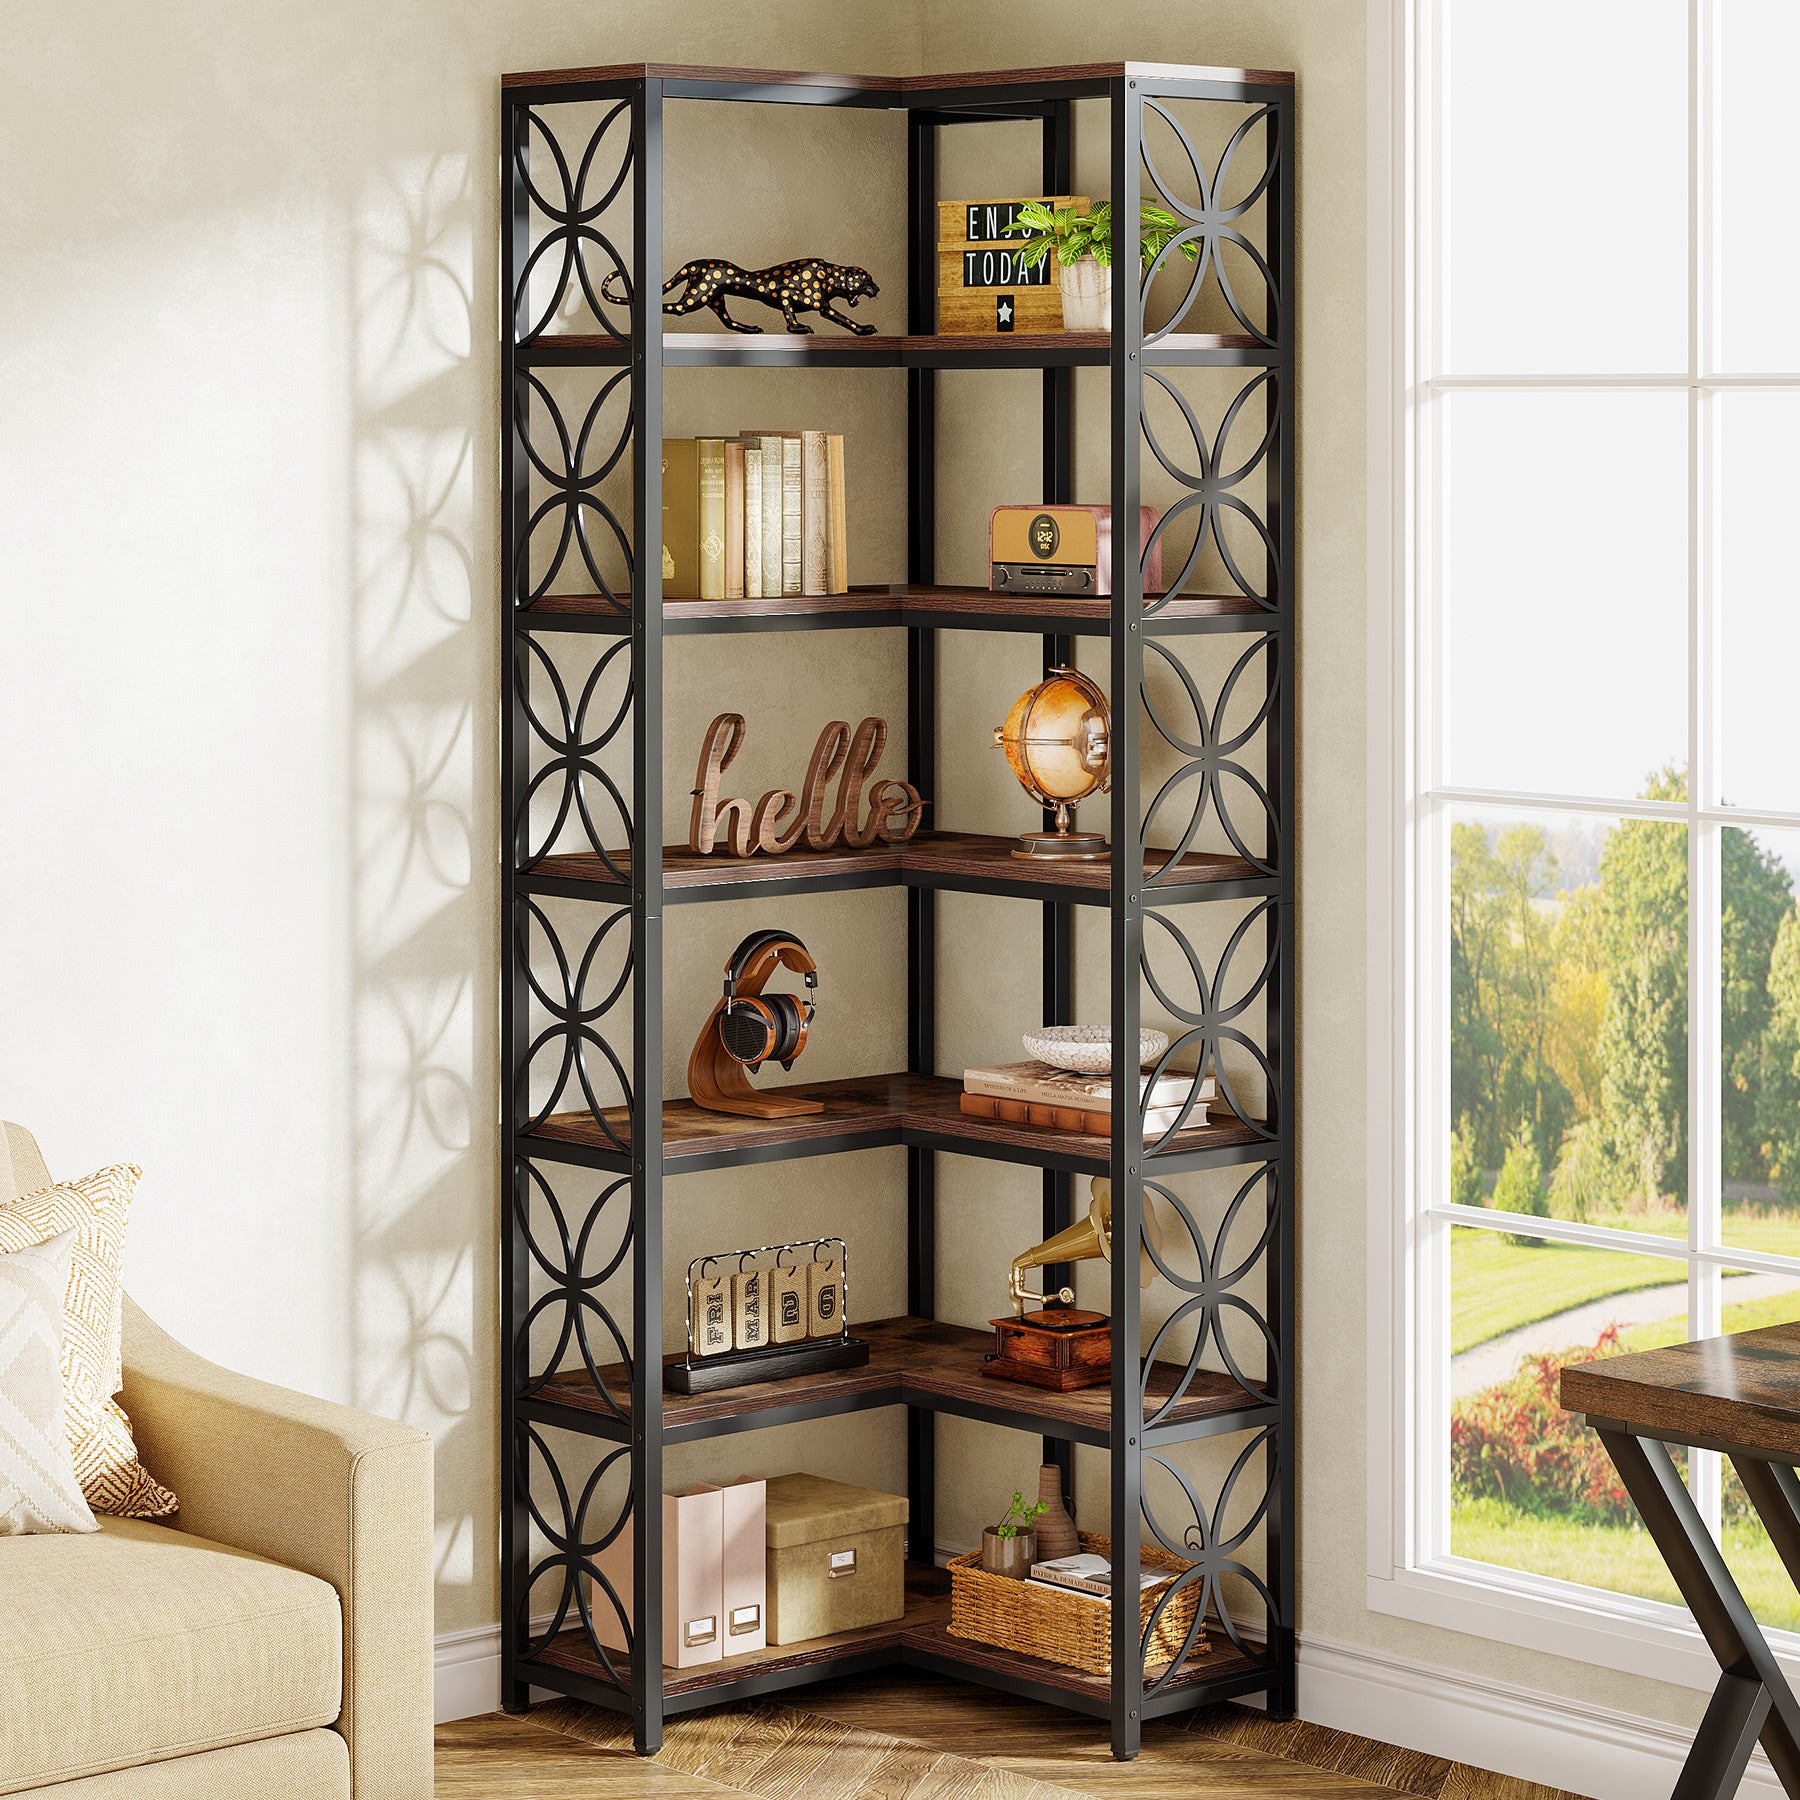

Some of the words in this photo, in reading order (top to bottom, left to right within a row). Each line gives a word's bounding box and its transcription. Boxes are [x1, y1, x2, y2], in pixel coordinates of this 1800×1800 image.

[970, 205, 1050, 239] ENJ
[966, 251, 1047, 285] TODAY
[689, 712, 932, 858] hello
[707, 1293, 724, 1345] FRI
[745, 1278, 760, 1342] MAR
[782, 1291, 799, 1326] 2
[818, 1284, 835, 1319] 6
[1033, 1568, 1059, 1581] PATRICK
[1060, 1576, 1109, 1593] DEMARCHELIER
